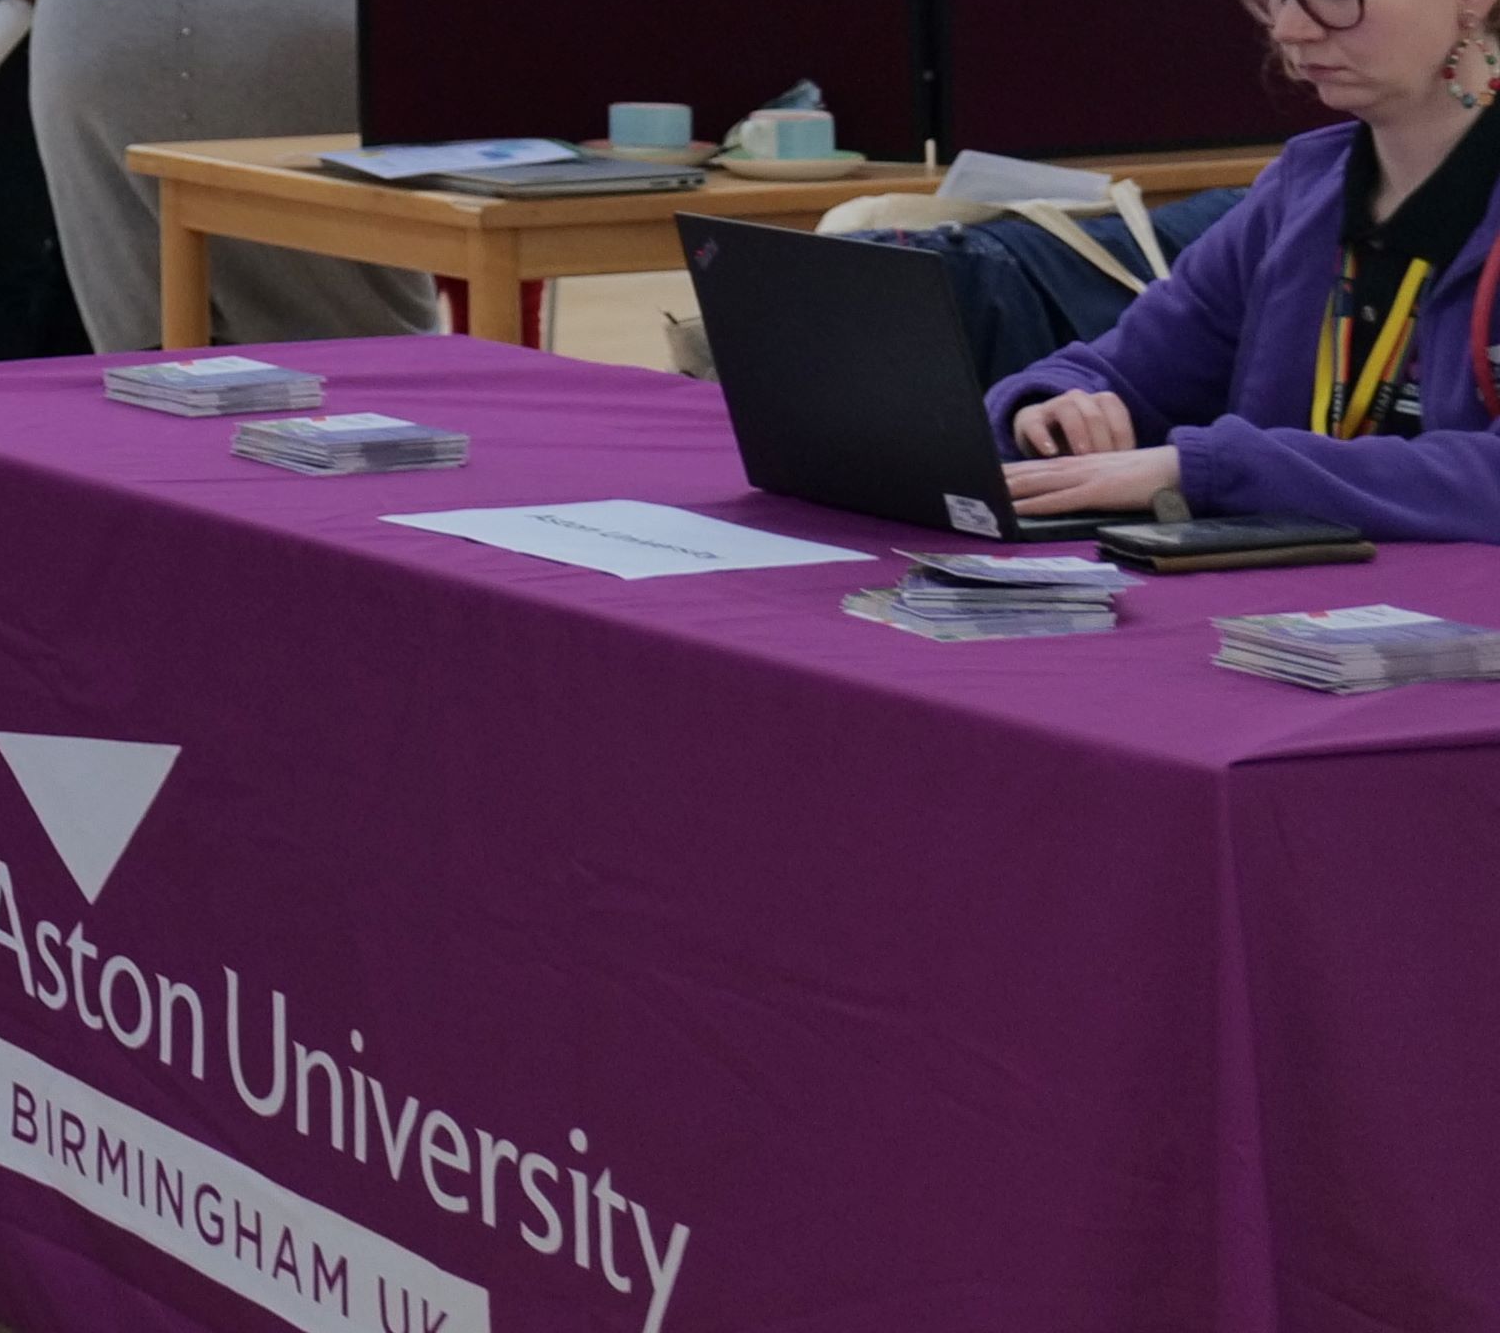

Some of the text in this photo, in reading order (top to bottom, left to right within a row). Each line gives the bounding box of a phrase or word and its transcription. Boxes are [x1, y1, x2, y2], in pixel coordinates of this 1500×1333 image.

[11, 1082, 450, 1333] BIRMINGHAM UK
[225, 966, 690, 1333] University
